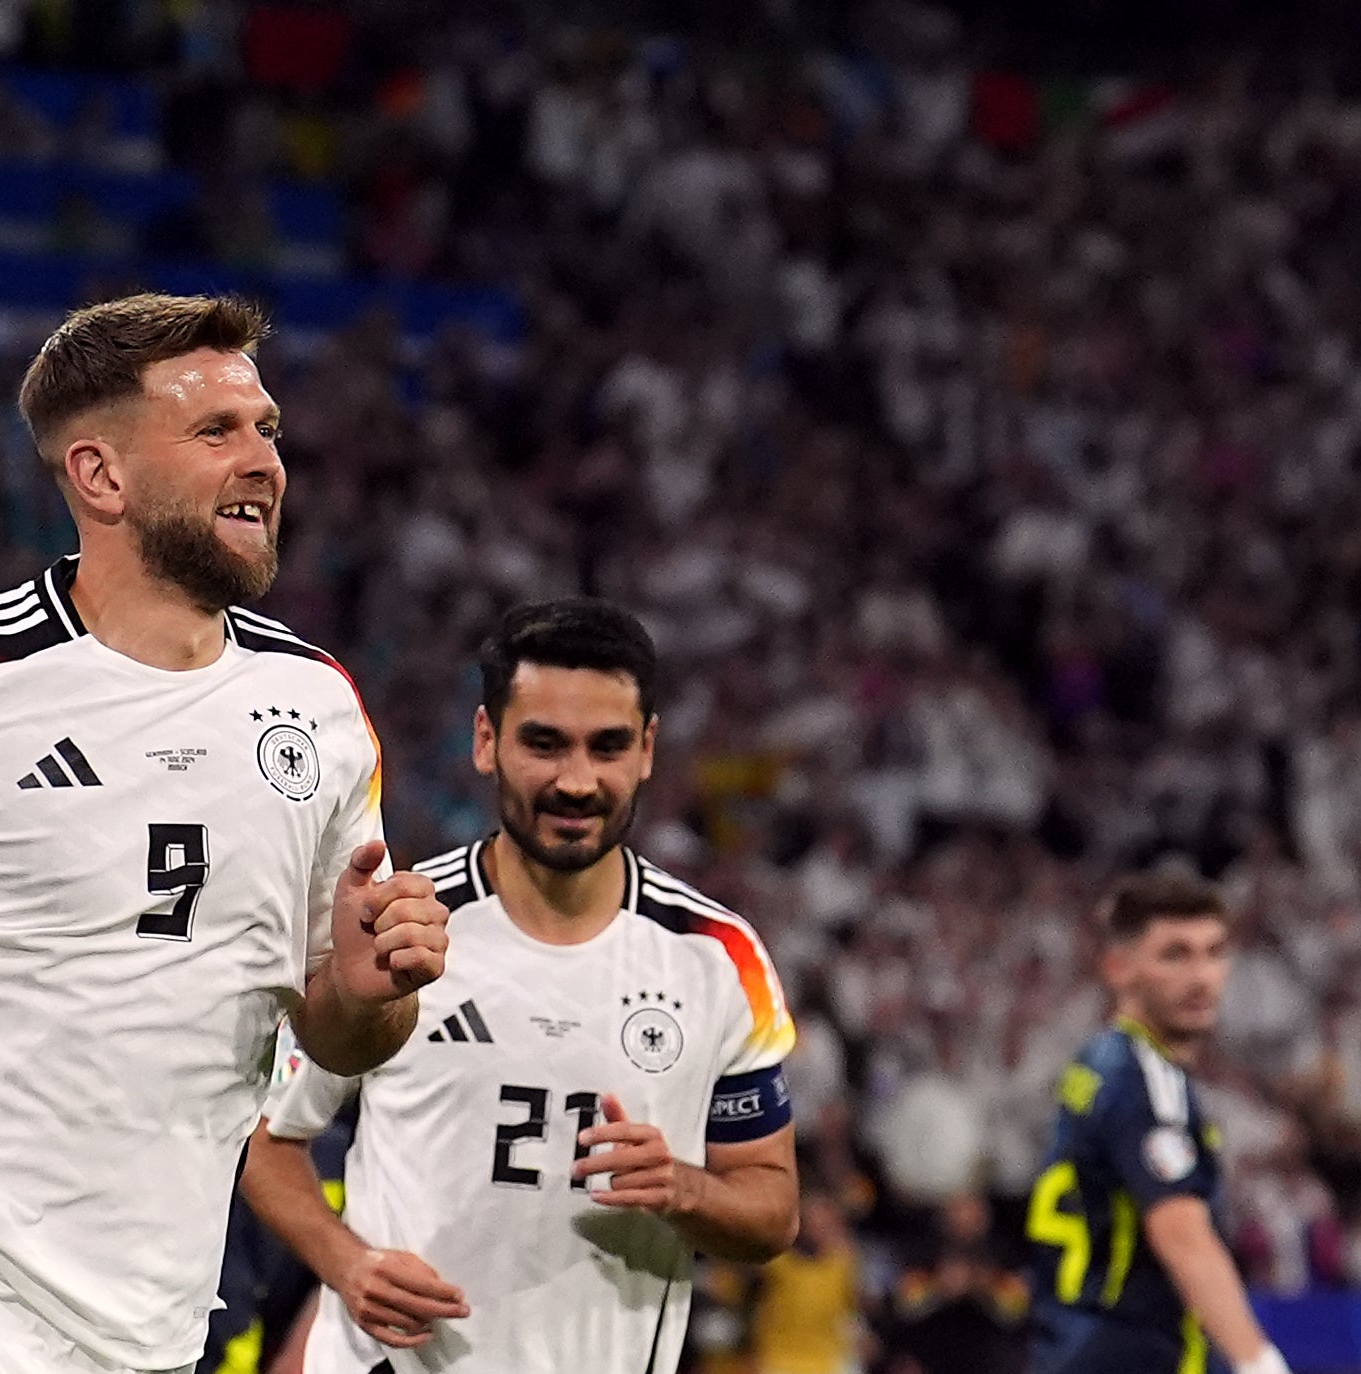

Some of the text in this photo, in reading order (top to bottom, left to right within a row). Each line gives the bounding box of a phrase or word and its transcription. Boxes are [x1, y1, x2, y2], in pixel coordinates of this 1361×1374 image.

[136, 823, 210, 942] 9
[491, 1084, 604, 1190] 21
[709, 1094, 761, 1116] PECT
